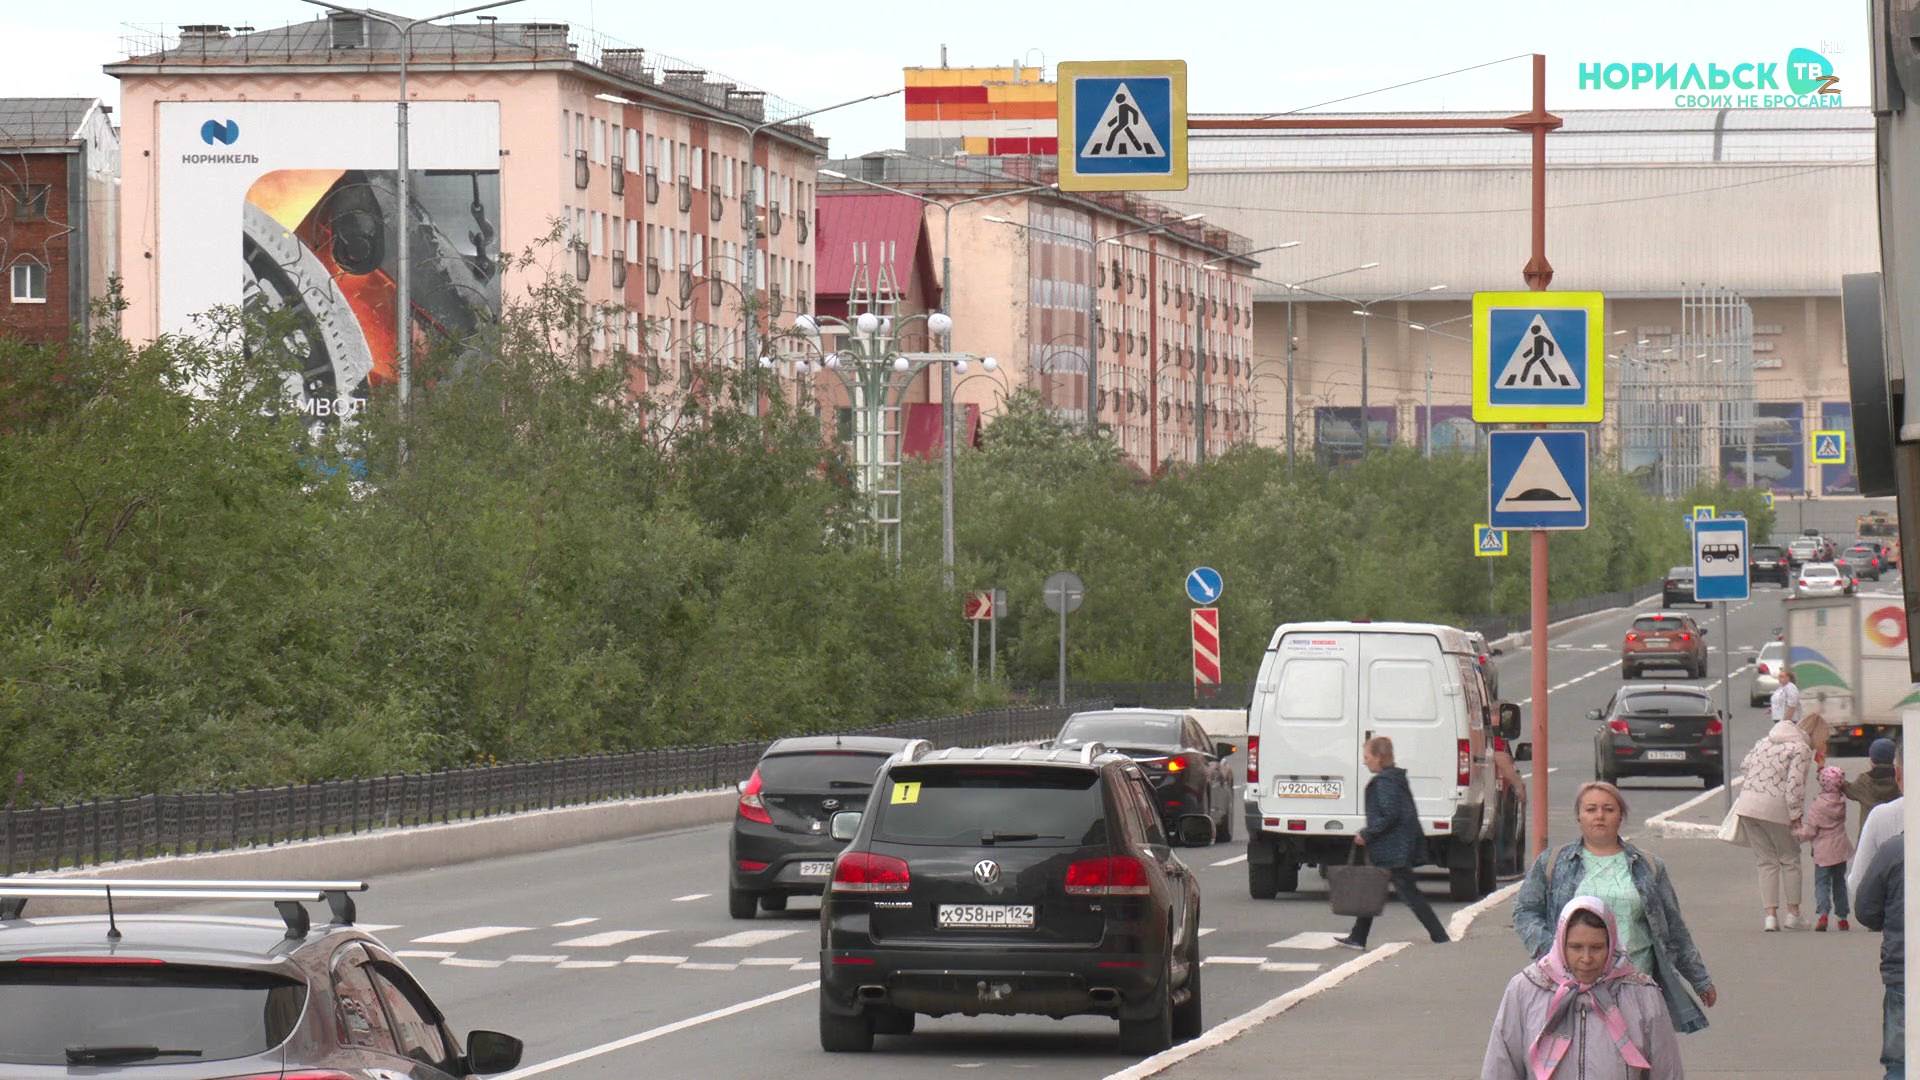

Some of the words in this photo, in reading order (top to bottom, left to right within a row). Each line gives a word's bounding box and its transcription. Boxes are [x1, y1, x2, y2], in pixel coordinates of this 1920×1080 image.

[182, 154, 260, 164] НОРНИКЕЛЬ
[1281, 783, 1319, 794] У920СК
[944, 907, 1004, 922] Х958НР
[1007, 906, 1031, 919] 124
